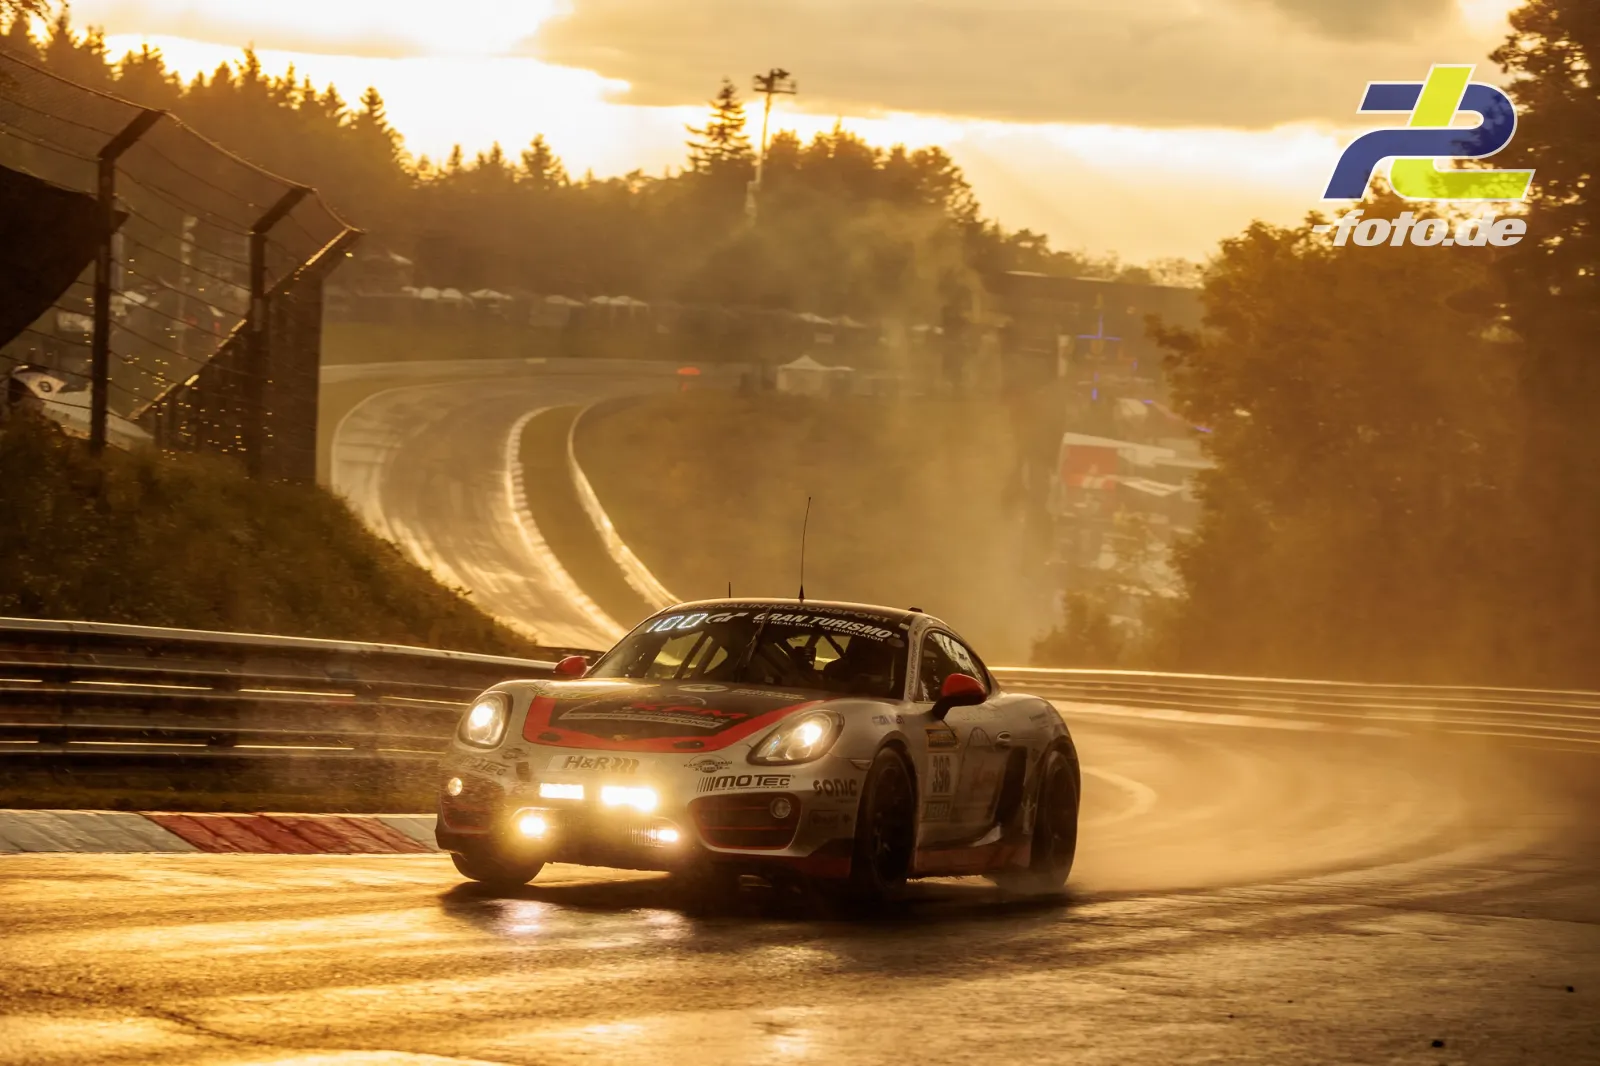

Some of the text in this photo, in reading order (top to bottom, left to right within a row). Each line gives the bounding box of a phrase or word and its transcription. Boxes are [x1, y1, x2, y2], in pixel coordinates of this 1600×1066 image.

[679, 602, 892, 623] RENALIN-MOTORSPORT
[753, 612, 893, 638] GRAN TURISMO
[795, 622, 830, 631] DRIVG
[833, 627, 884, 642] SIMULATOR
[563, 755, 610, 770] H&R
